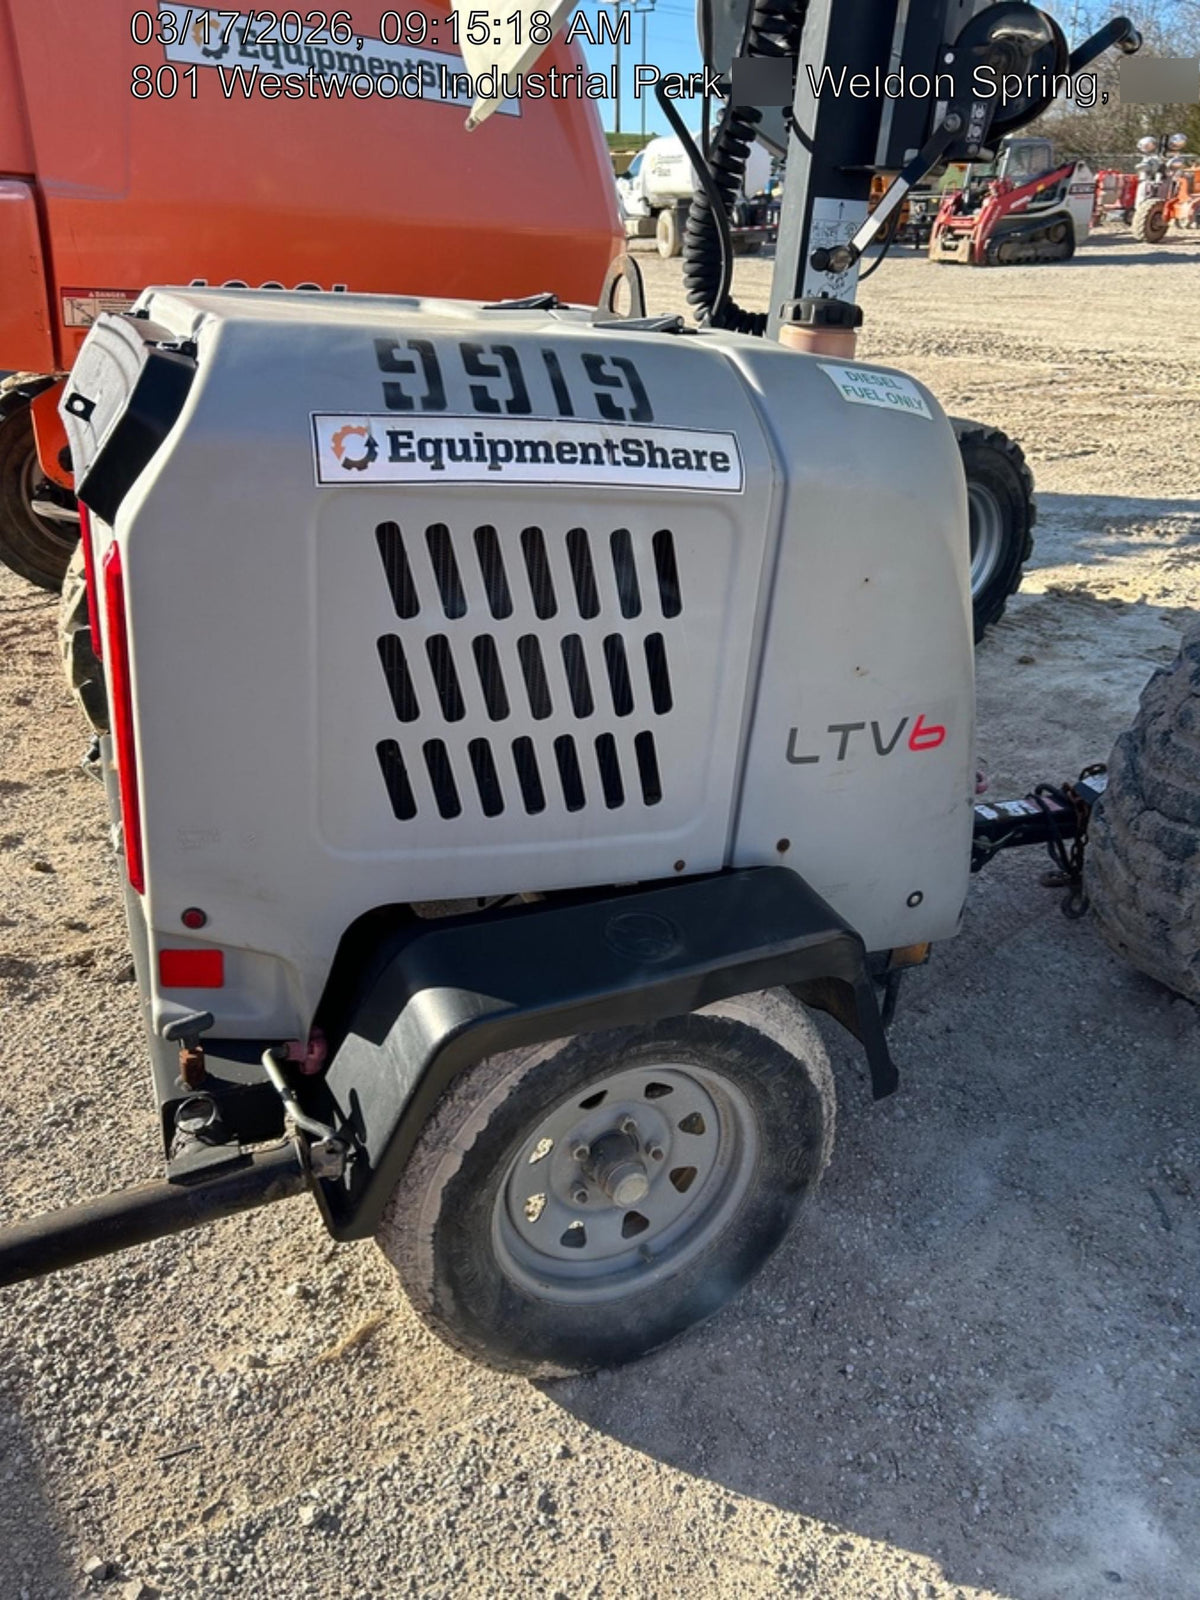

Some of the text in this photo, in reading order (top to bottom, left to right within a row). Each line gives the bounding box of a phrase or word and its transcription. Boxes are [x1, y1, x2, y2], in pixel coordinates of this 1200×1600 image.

[373, 338, 655, 422] 9919
[842, 385, 923, 410] FUEL ONLY
[844, 371, 902, 390] DIESEL
[385, 428, 731, 473] EquipmentShare
[786, 713, 946, 765] LTV6
